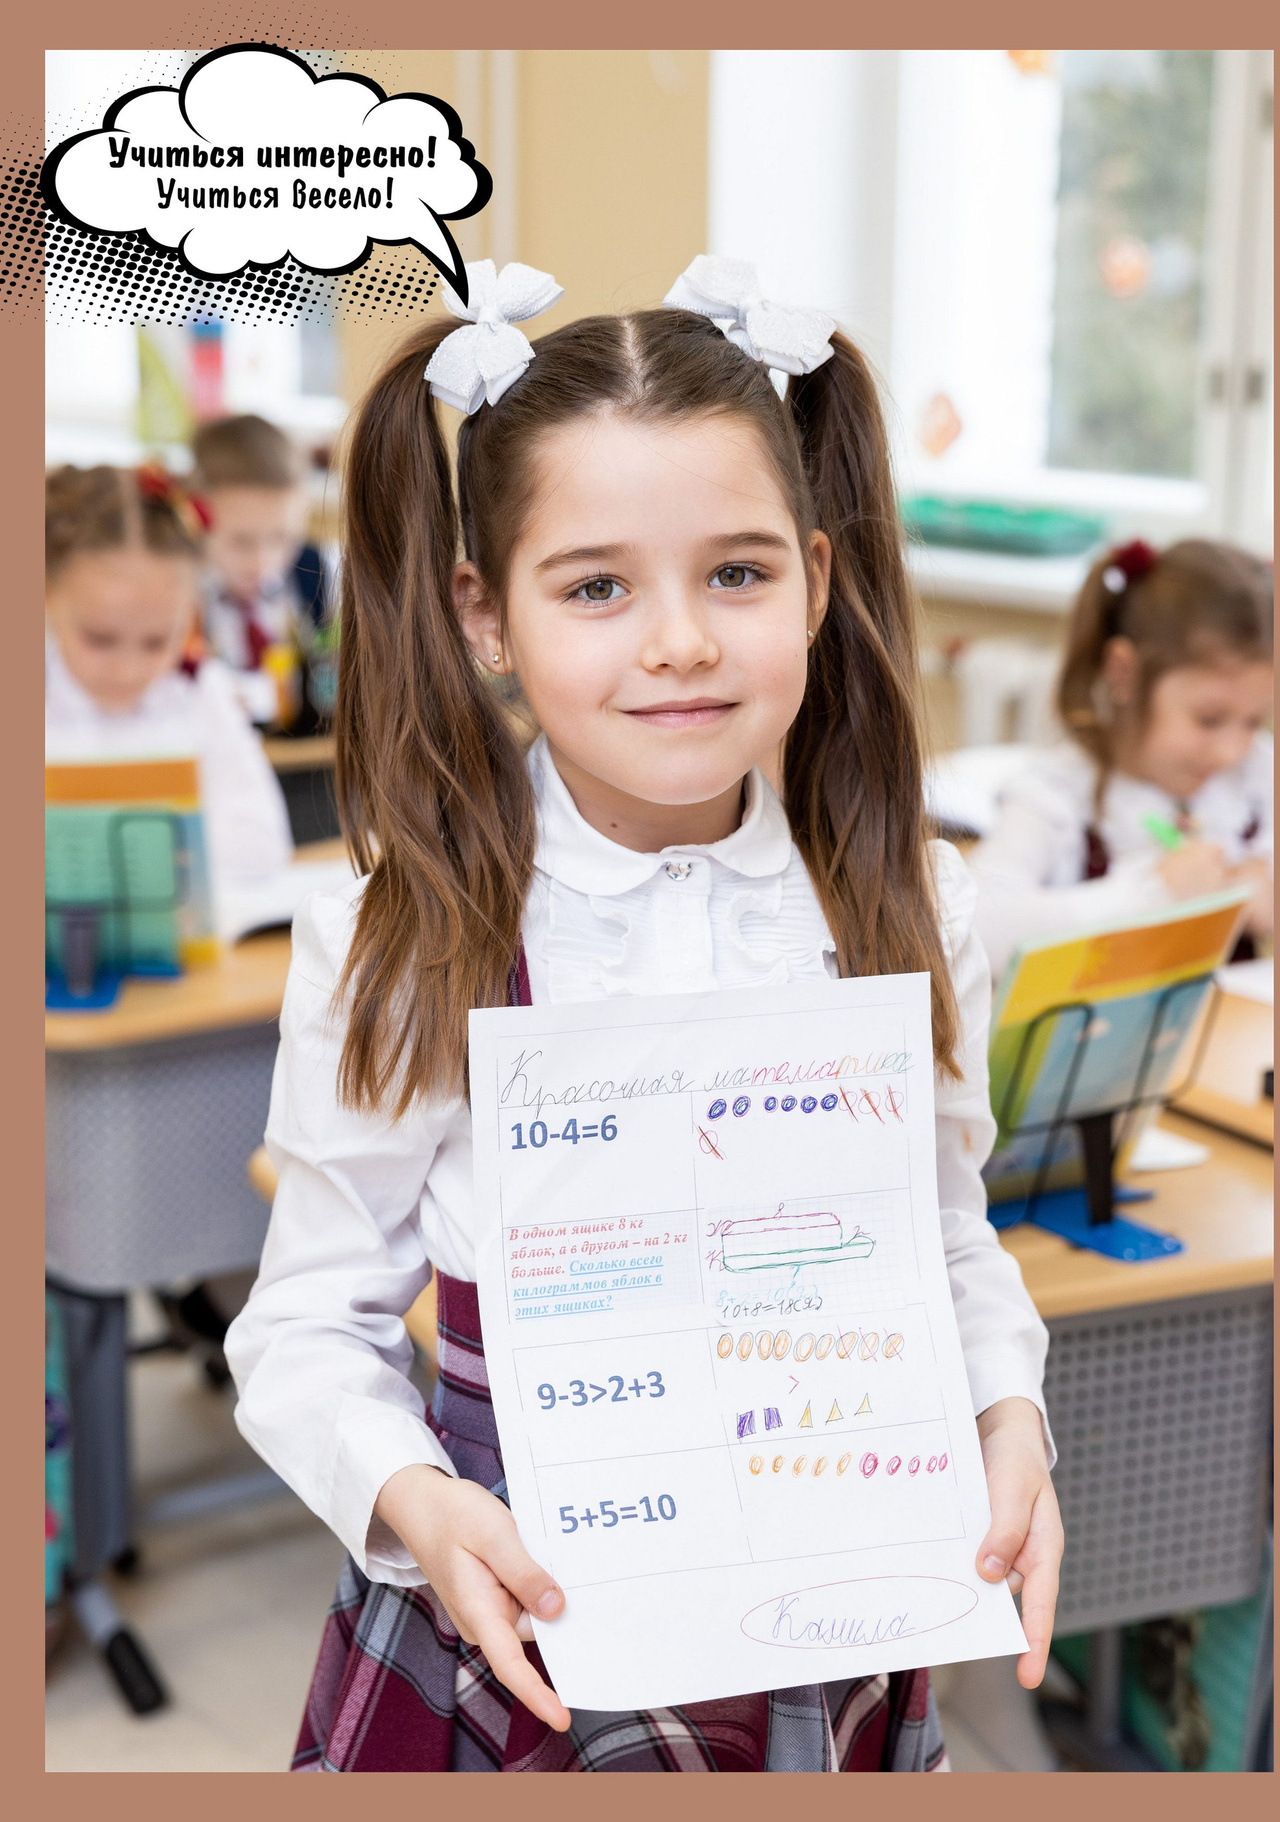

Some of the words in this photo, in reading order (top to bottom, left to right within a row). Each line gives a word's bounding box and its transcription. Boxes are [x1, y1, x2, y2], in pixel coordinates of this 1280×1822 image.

[500, 1049, 696, 1120] Красочная
[511, 1114, 618, 1150] 10-4=6
[509, 1228, 519, 1241] В
[522, 1226, 567, 1240] одном
[571, 1221, 614, 1236] ящике
[618, 1218, 626, 1230] 8
[629, 1219, 644, 1230] кг
[510, 1246, 555, 1260] яблок,
[559, 1245, 567, 1255] а
[570, 1245, 577, 1254] в
[581, 1240, 629, 1256] другом
[644, 1236, 660, 1247] на
[663, 1232, 671, 1245] 2
[674, 1233, 688, 1243] кг
[511, 1266, 565, 1279] больше.
[569, 1259, 626, 1273] Сколько
[630, 1254, 663, 1267] всего
[513, 1281, 608, 1298] килограммов
[611, 1273, 652, 1288] яблок
[655, 1273, 662, 1283] в
[515, 1303, 549, 1317] этих
[554, 1294, 613, 1313] ящиках?
[537, 1370, 667, 1411] 9-3>2+3
[559, 1493, 678, 1534] 5+5=10
